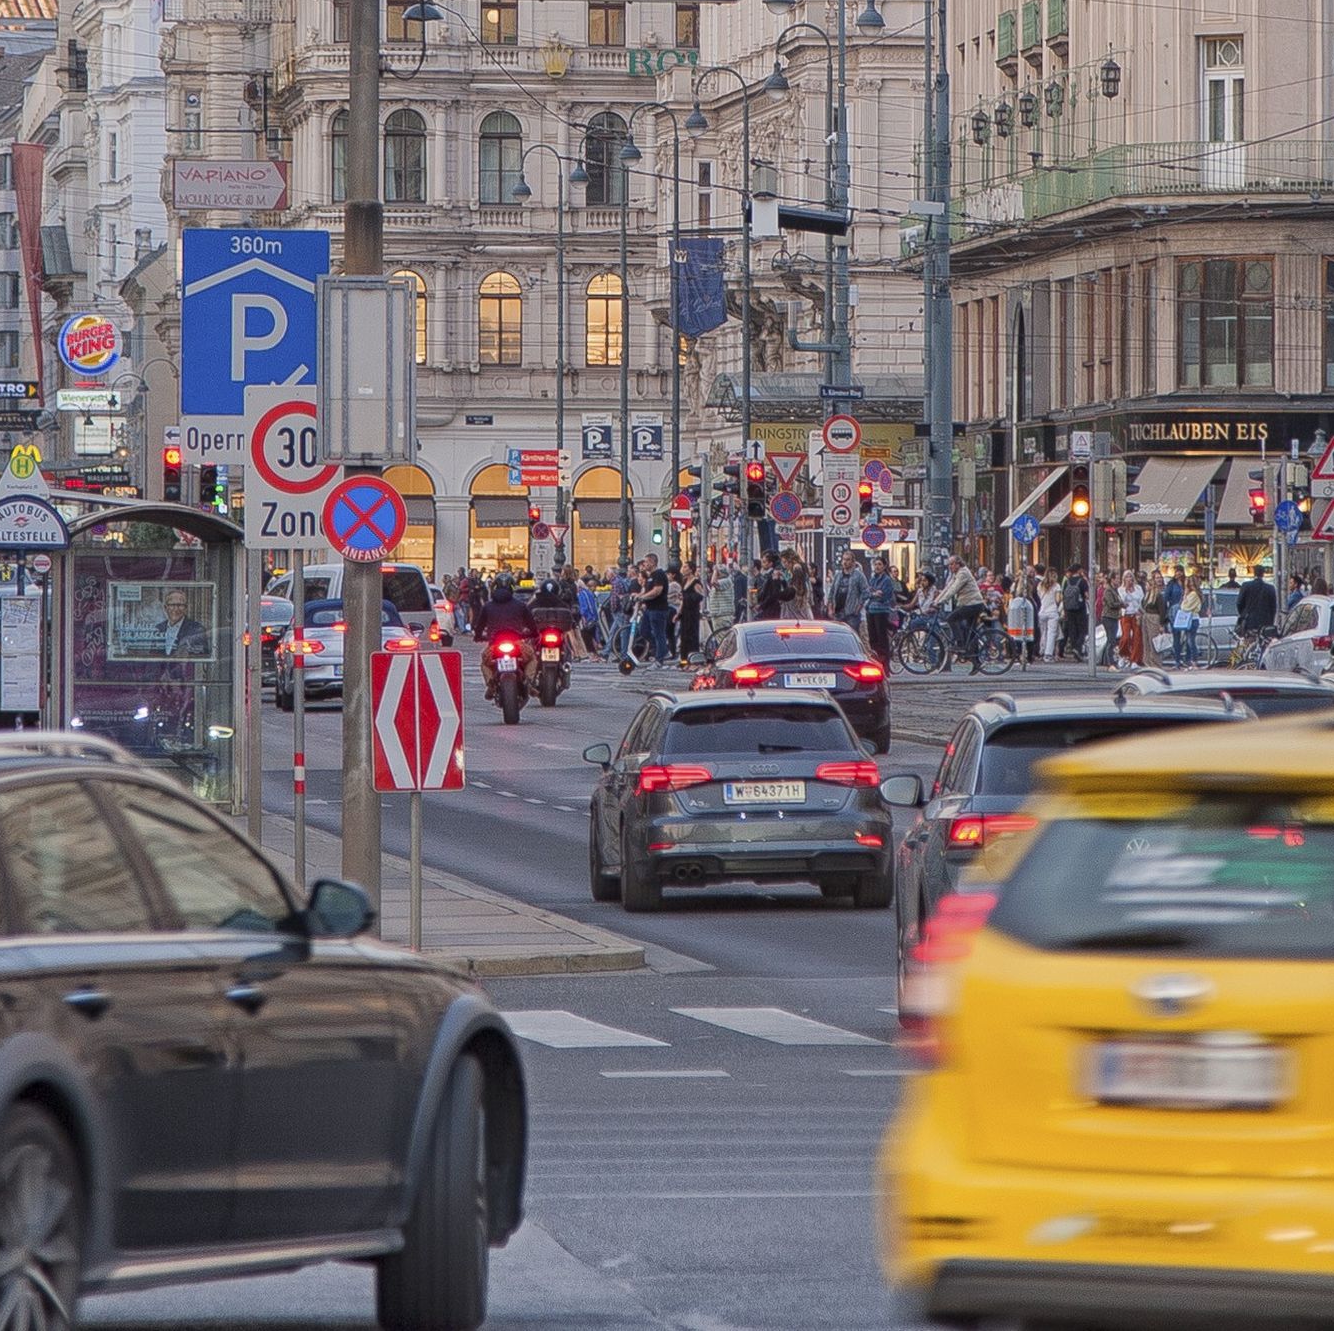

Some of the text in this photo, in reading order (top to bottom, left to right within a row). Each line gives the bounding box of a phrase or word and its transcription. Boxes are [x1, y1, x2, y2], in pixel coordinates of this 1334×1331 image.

[66, 323, 114, 346] BURGER
[231, 293, 288, 381] P
[68, 335, 115, 361] KING
[1130, 423, 1268, 441] TUCHLAUBEN EIS
[277, 427, 316, 469] 30
[260, 502, 324, 537] Zon
[342, 544, 388, 562] ANFANG
